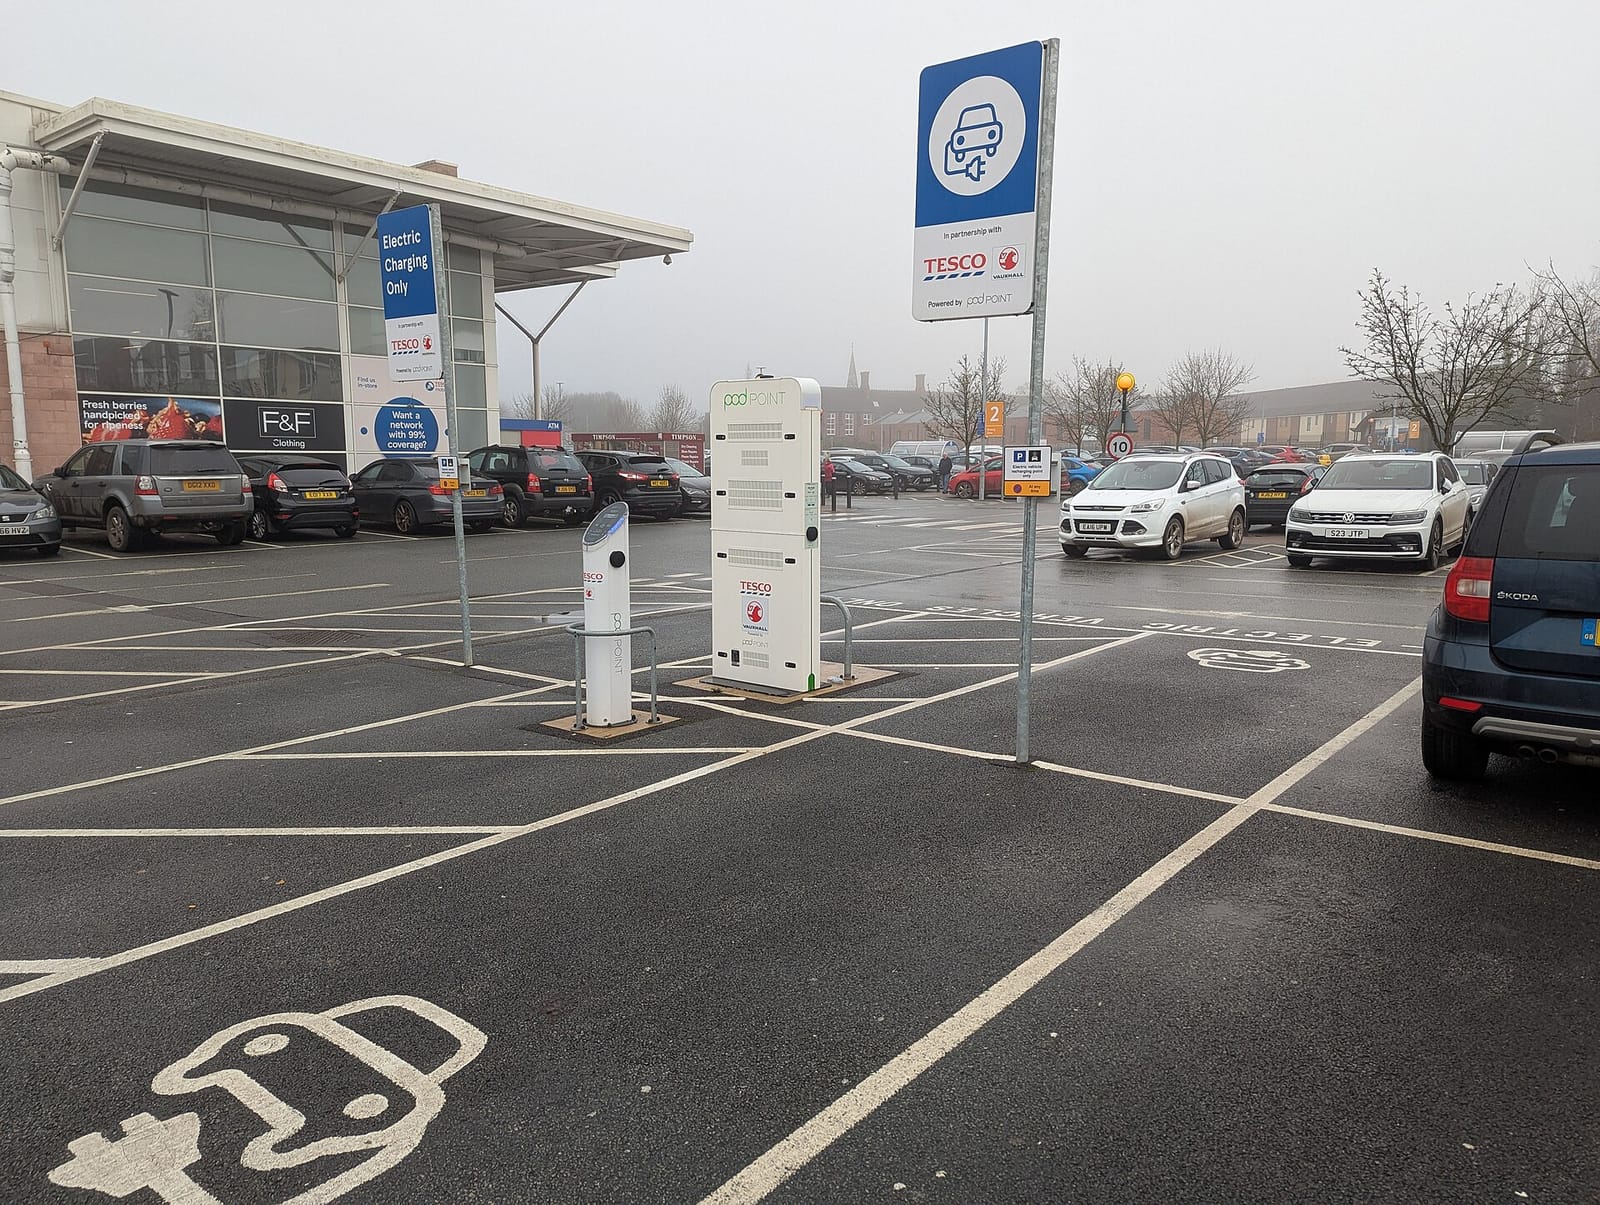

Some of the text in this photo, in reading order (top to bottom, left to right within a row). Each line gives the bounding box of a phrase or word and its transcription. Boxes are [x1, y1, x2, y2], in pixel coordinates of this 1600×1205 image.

[950, 227, 987, 240] partnership
[988, 225, 1002, 234] with
[383, 230, 421, 249] Electric
[384, 254, 428, 273] Charging
[923, 253, 1024, 280] TESCO VAUXHALL
[386, 280, 408, 297] Only
[928, 300, 954, 308] Powered
[955, 299, 962, 307] by
[986, 294, 1013, 304] POINT
[391, 339, 419, 350] TESCO
[82, 400, 148, 410] Fresh berries
[724, 387, 786, 412] pod POINT
[83, 410, 140, 421] handpicked
[392, 410, 413, 420] Want
[990, 406, 1000, 422] 2
[84, 421, 144, 432] for ripeness
[262, 411, 311, 434] F&F
[390, 421, 424, 430] network
[1412, 424, 1417, 432] 2
[388, 430, 426, 439] with 99%
[272, 438, 306, 449] Clothing
[387, 440, 427, 450] coverage?
[1112, 441, 1128, 452] 10
[740, 580, 772, 592] TESCO
[837, 597, 904, 607] ONL
[1141, 621, 1383, 648] ELECTRIC
[614, 638, 622, 675] POINT
